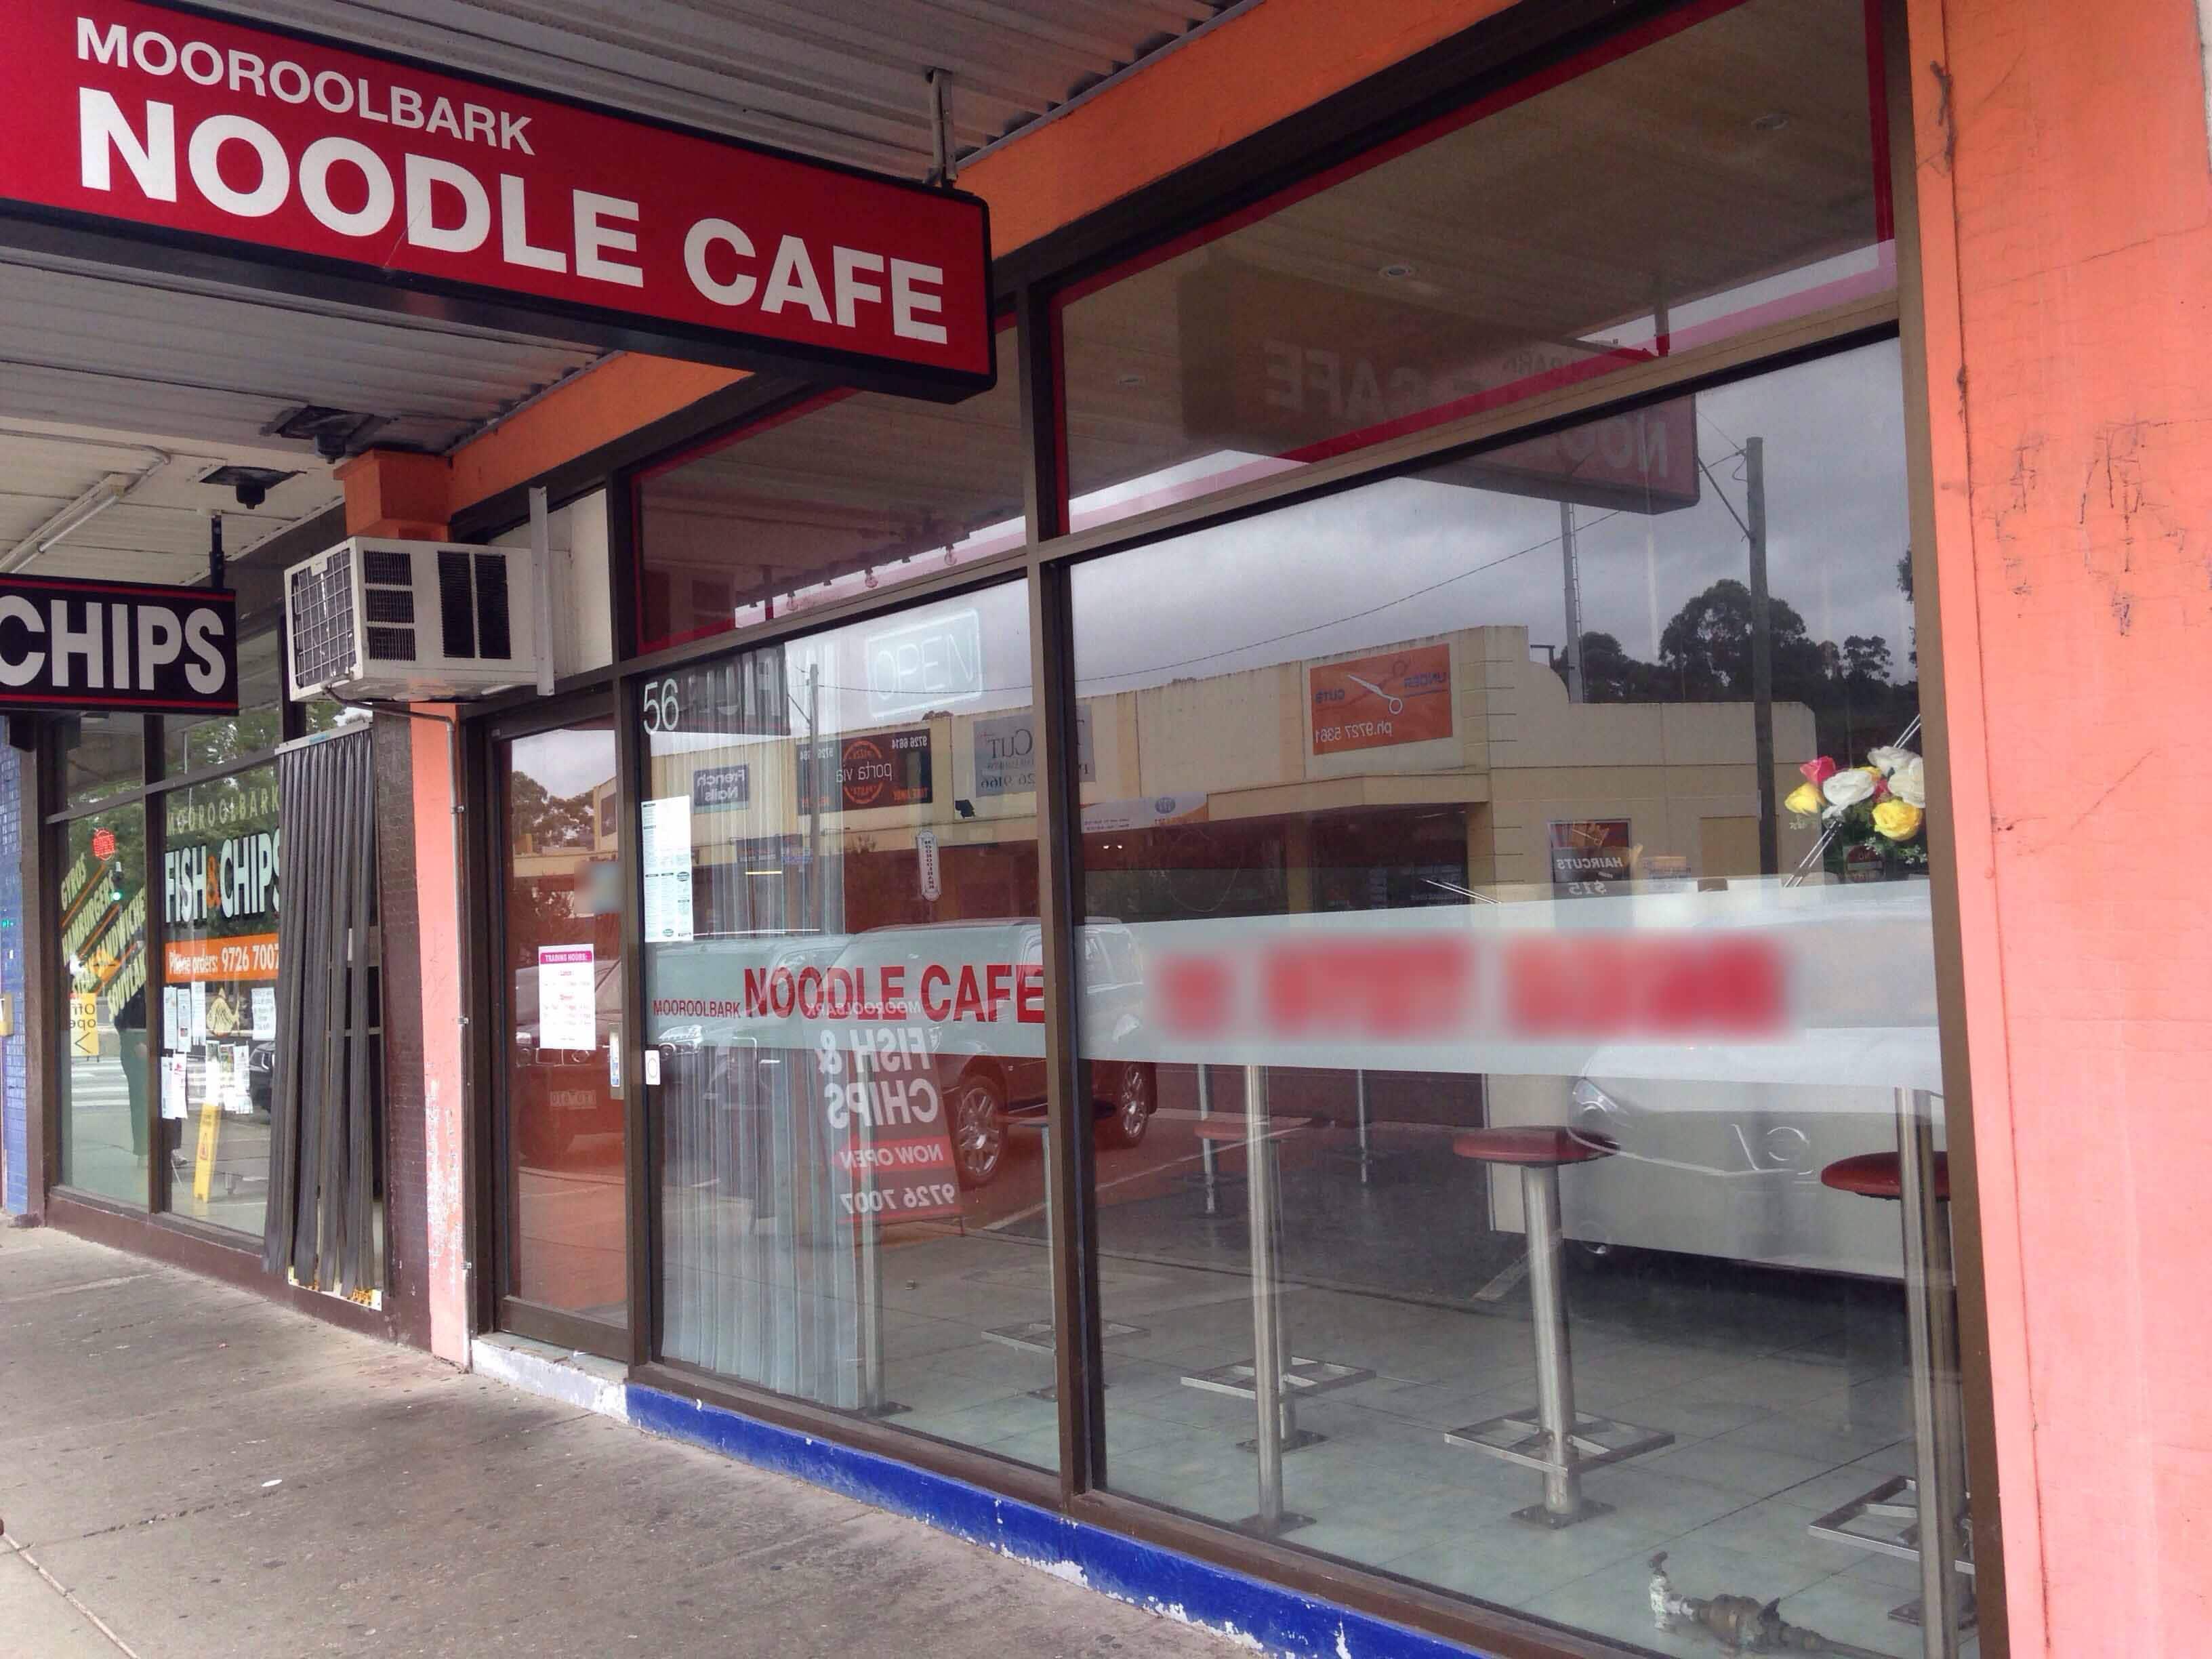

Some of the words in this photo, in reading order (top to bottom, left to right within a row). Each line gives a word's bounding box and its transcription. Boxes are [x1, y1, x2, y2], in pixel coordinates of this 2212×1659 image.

[77, 16, 535, 156] MOOROOLBARK
[79, 86, 644, 288] NOODLE
[684, 218, 947, 345] CAFE
[0, 595, 226, 694] CHIPS
[873, 628, 974, 701] OPEN
[644, 678, 678, 735] 56
[166, 785, 279, 836] MOOROOLBARK
[61, 852, 86, 912] GYROS
[165, 845, 207, 923] FISH
[207, 856, 221, 909] &
[222, 947, 249, 972] 9726
[545, 954, 567, 962] TRADING
[653, 999, 741, 1019] MOOROOLBARK
[743, 966, 907, 1021] NOODLE
[920, 964, 1046, 1024] CAFE
